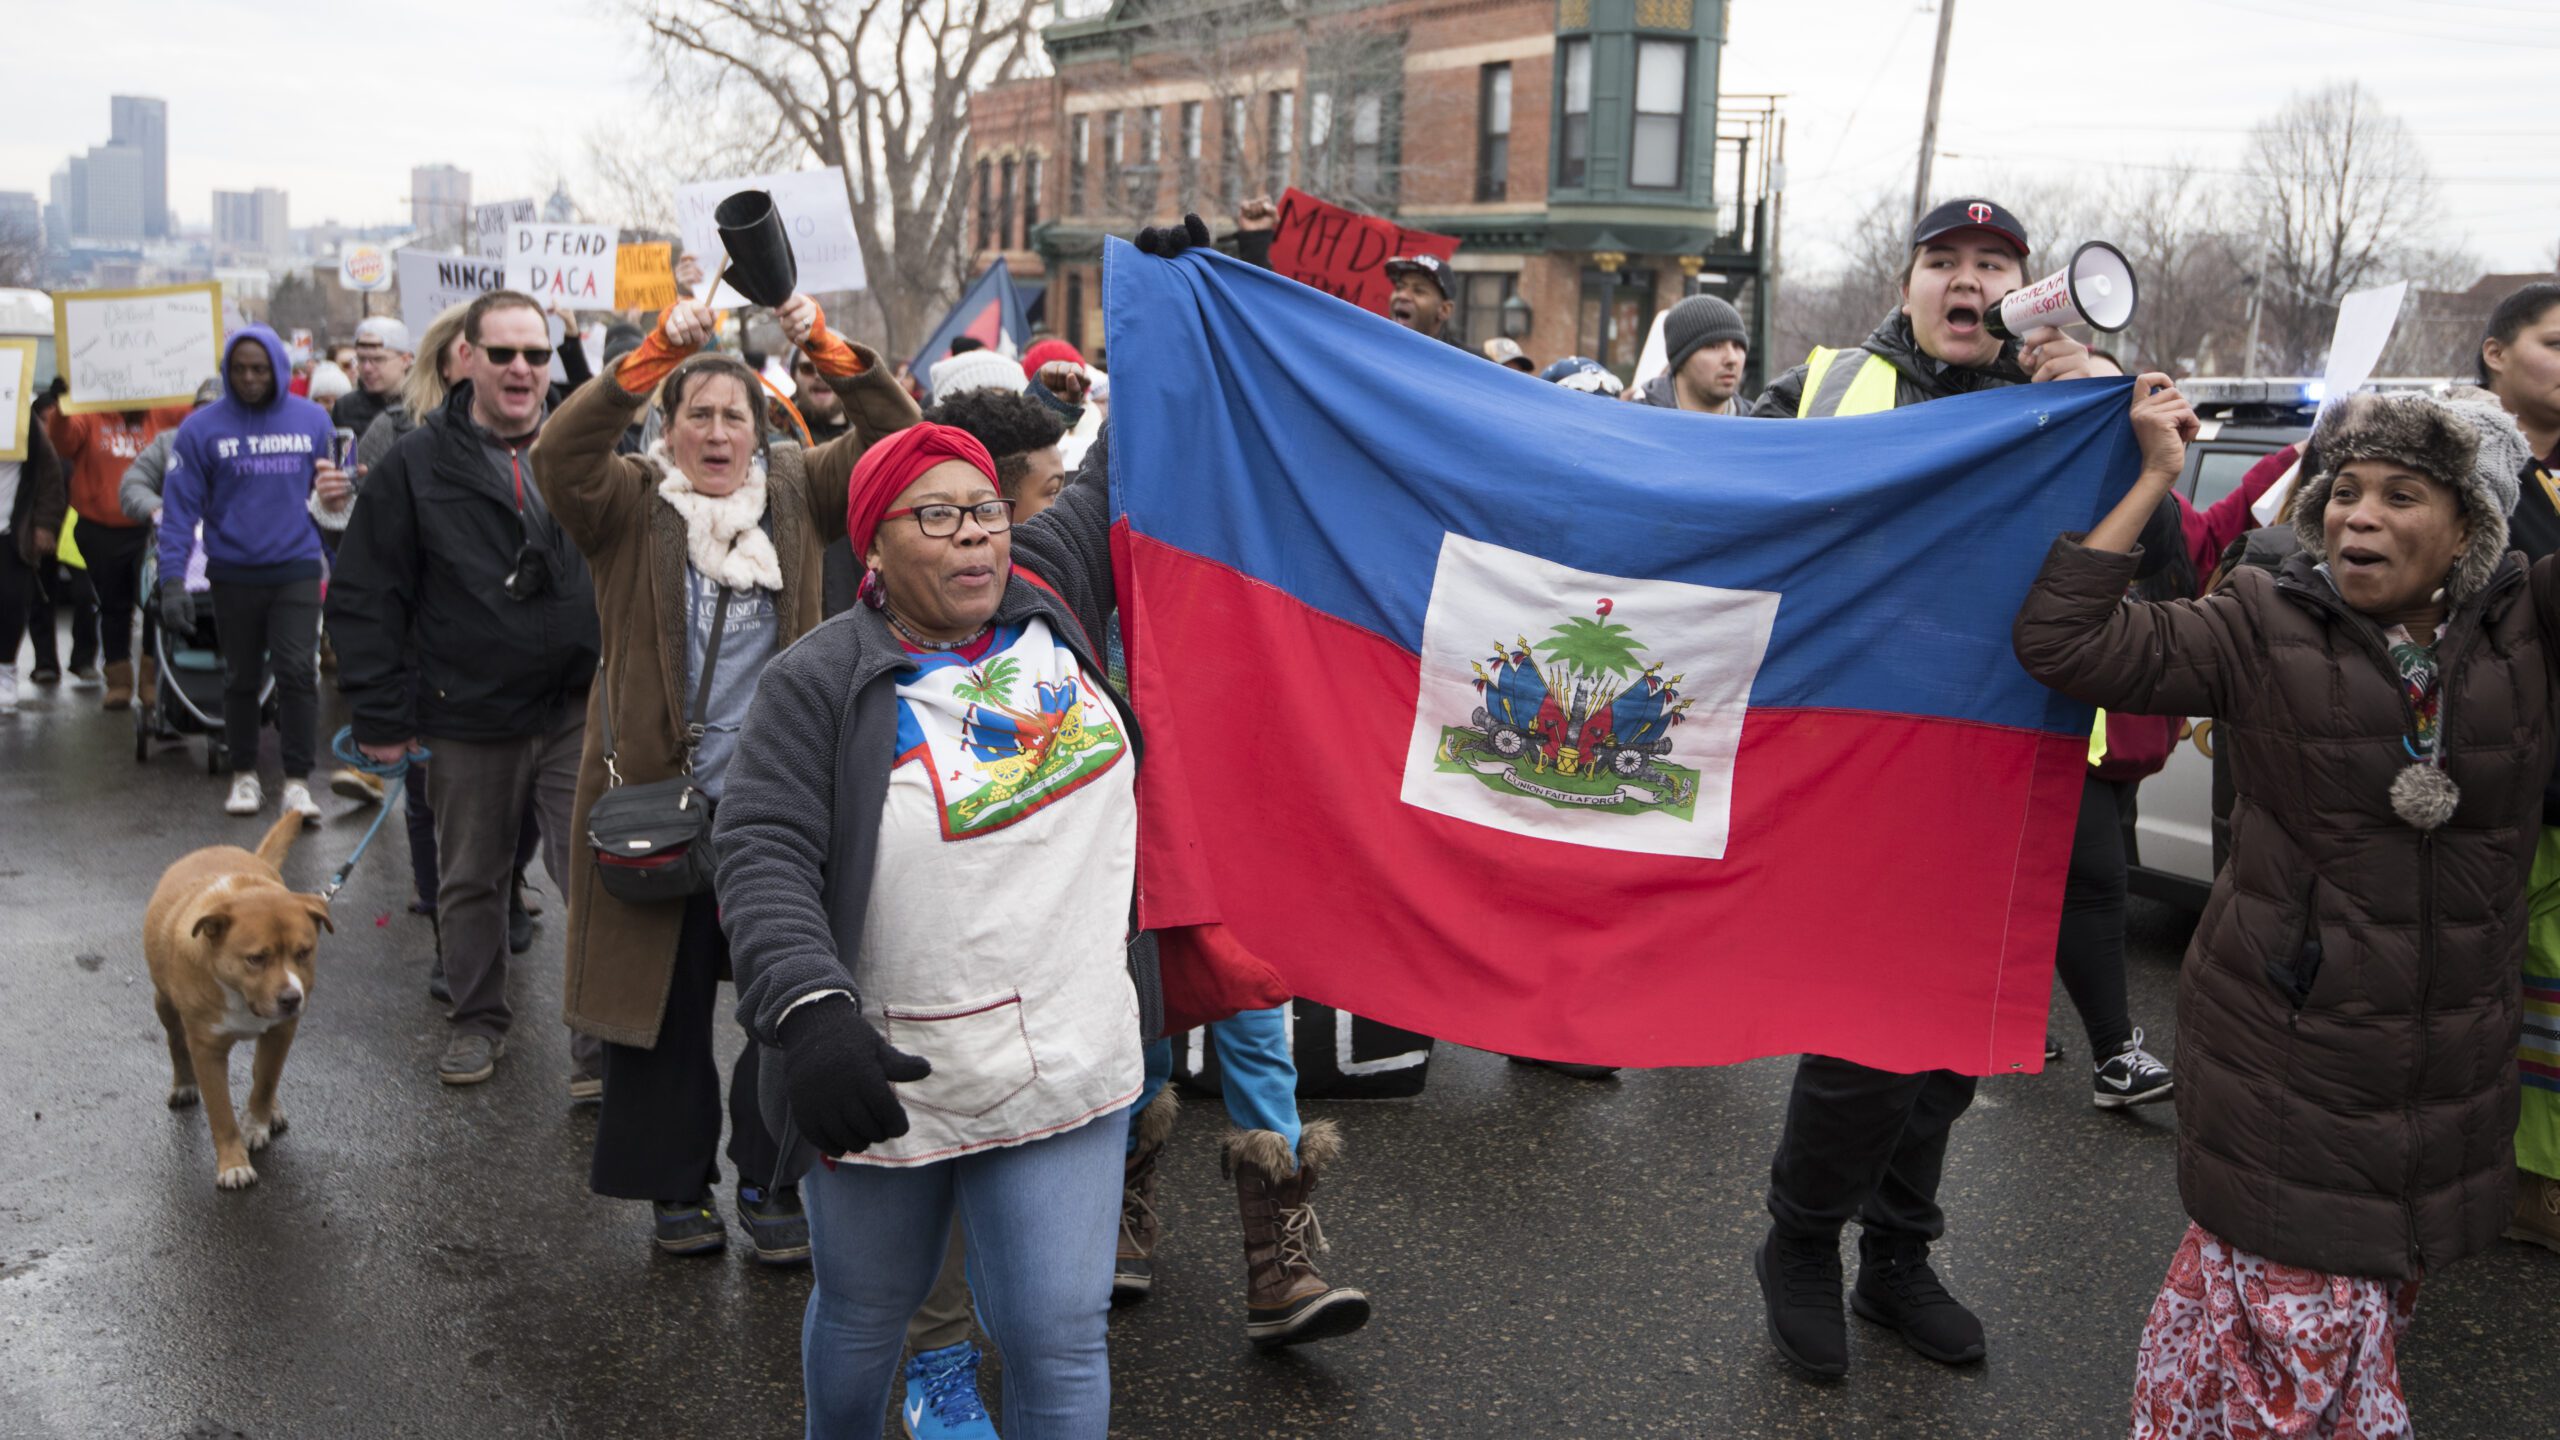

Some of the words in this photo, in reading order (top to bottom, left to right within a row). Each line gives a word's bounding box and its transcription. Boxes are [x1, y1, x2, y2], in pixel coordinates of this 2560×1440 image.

[519, 230, 608, 257] DFEND
[531, 266, 597, 298] DACA
[110, 329, 159, 351] DACA
[218, 437, 240, 459] ST
[246, 433, 313, 455] THOMAS
[1506, 774, 1544, 796] L'UNION
[1544, 789, 1568, 801] FAIT
